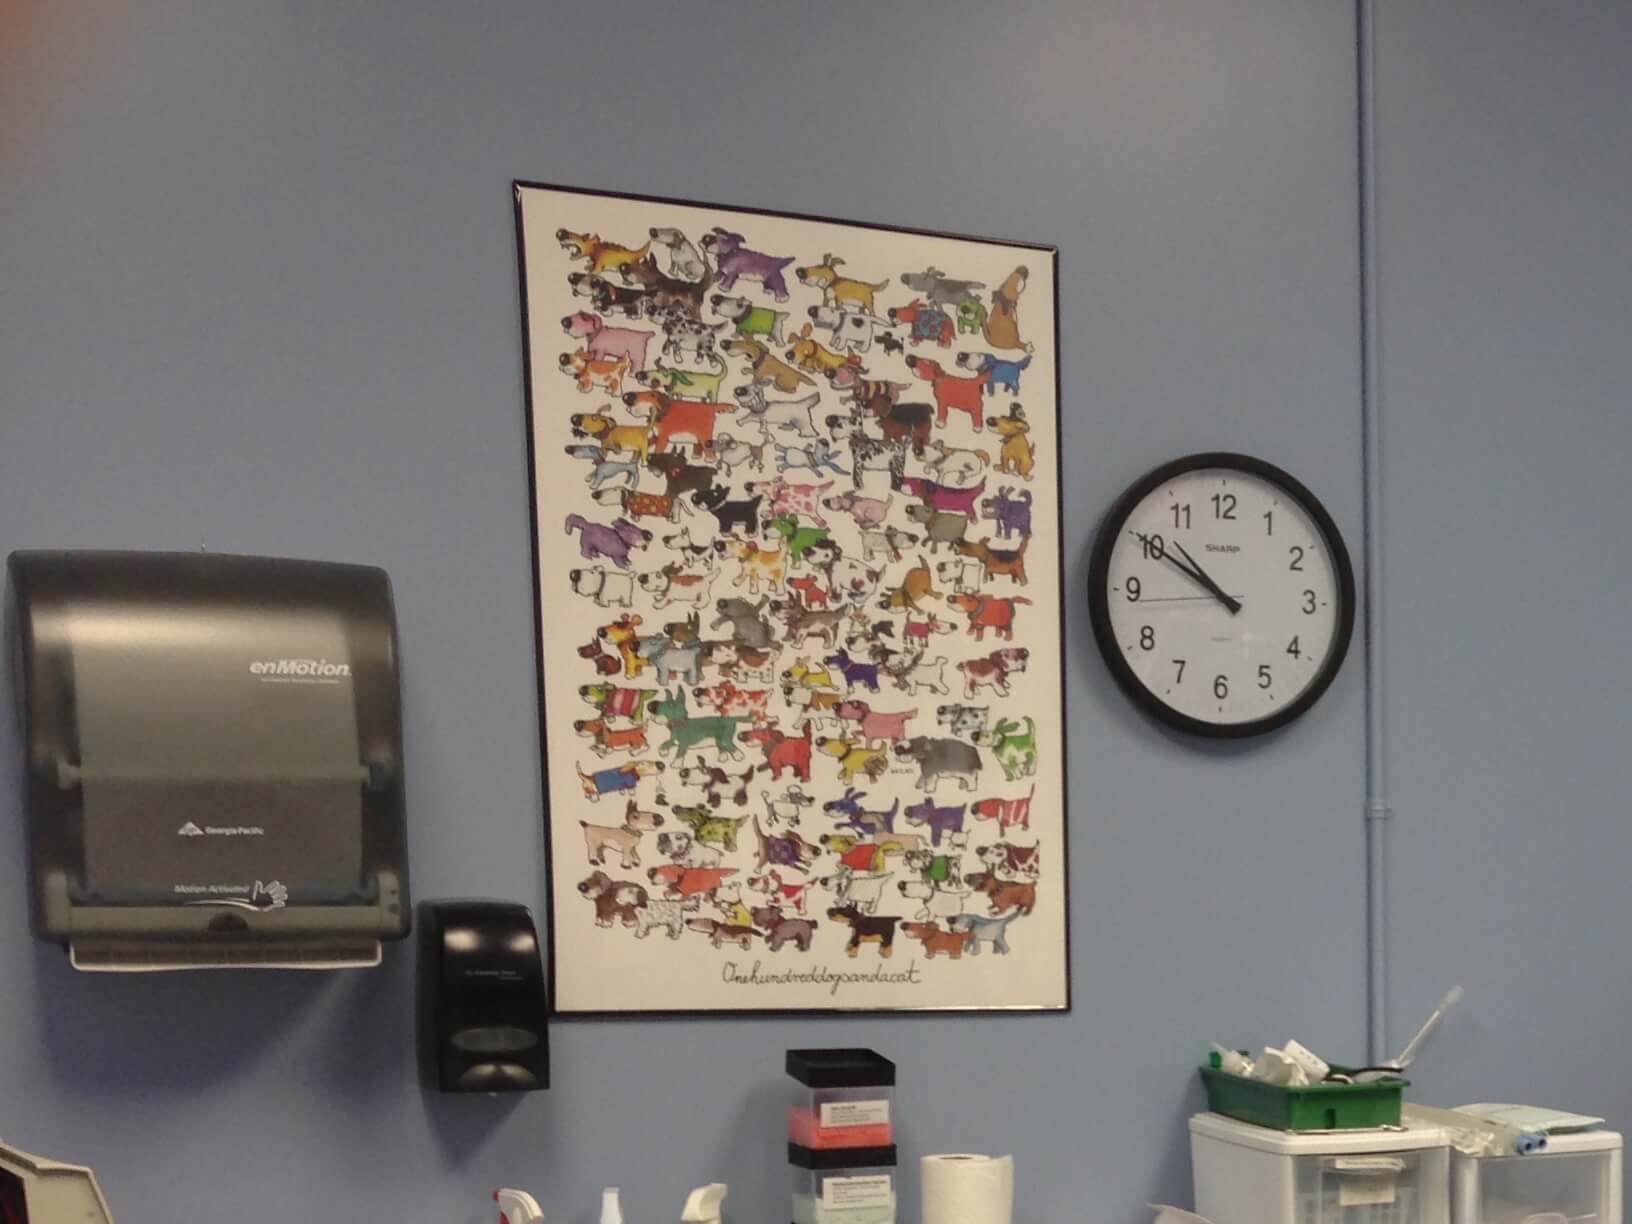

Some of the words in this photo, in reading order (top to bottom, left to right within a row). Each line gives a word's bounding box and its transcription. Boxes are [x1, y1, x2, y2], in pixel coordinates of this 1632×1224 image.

[1170, 503, 1191, 529] 11
[1211, 494, 1237, 520] 12
[1263, 511, 1273, 536] 1
[1141, 534, 1164, 560] 10
[1205, 543, 1241, 554] SHARP
[1289, 546, 1303, 571] 2
[1126, 576, 1141, 602] 9
[1302, 590, 1316, 615] 3
[1140, 625, 1155, 651] 8
[1286, 635, 1301, 660] 4
[249, 659, 350, 676] enMotion
[1172, 660, 1186, 684] 7
[1258, 665, 1272, 689] 5
[1214, 675, 1228, 699] 6
